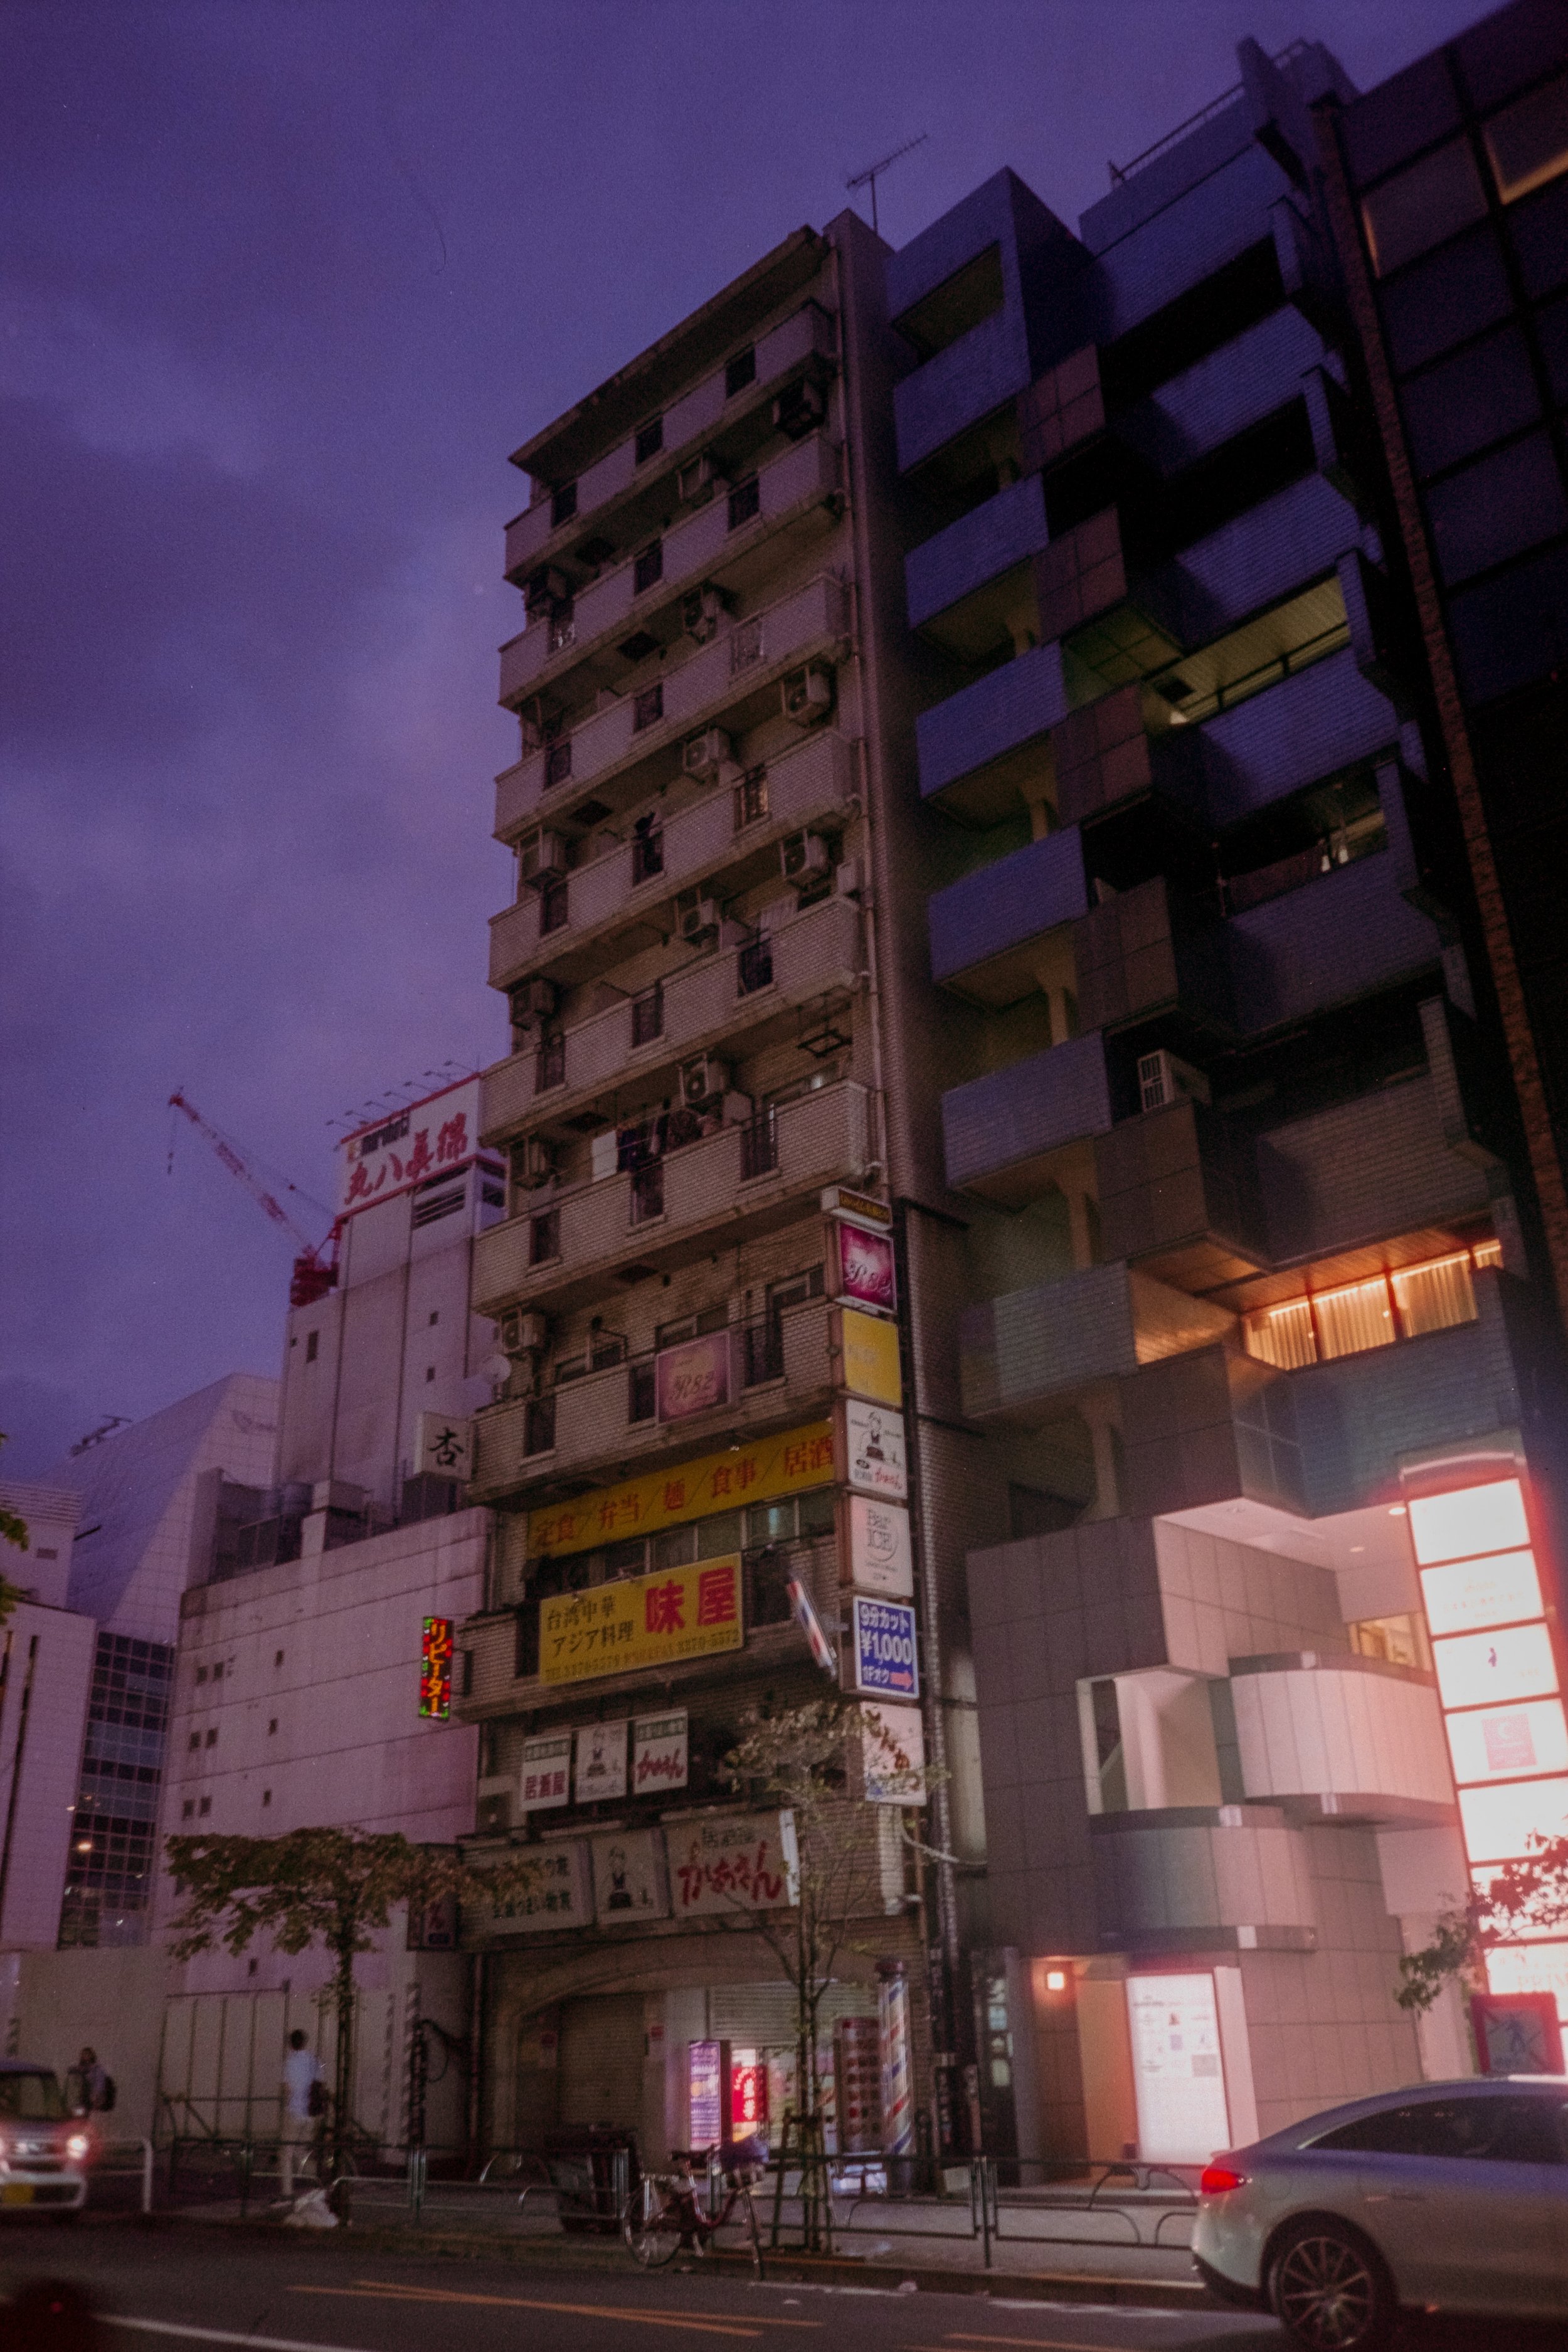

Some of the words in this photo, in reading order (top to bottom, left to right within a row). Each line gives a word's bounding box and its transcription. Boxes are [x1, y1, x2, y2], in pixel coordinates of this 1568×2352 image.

[427, 1426, 464, 1468] 杏
[598, 1492, 642, 1530] 弁当
[712, 1456, 756, 1499] 食事
[546, 1594, 616, 1633] 台湾中華
[644, 1565, 738, 1635] 味屋
[552, 1620, 635, 1658] アジア料理
[860, 1628, 913, 1666] ¥1,000
[677, 1839, 783, 1907] かあさん
